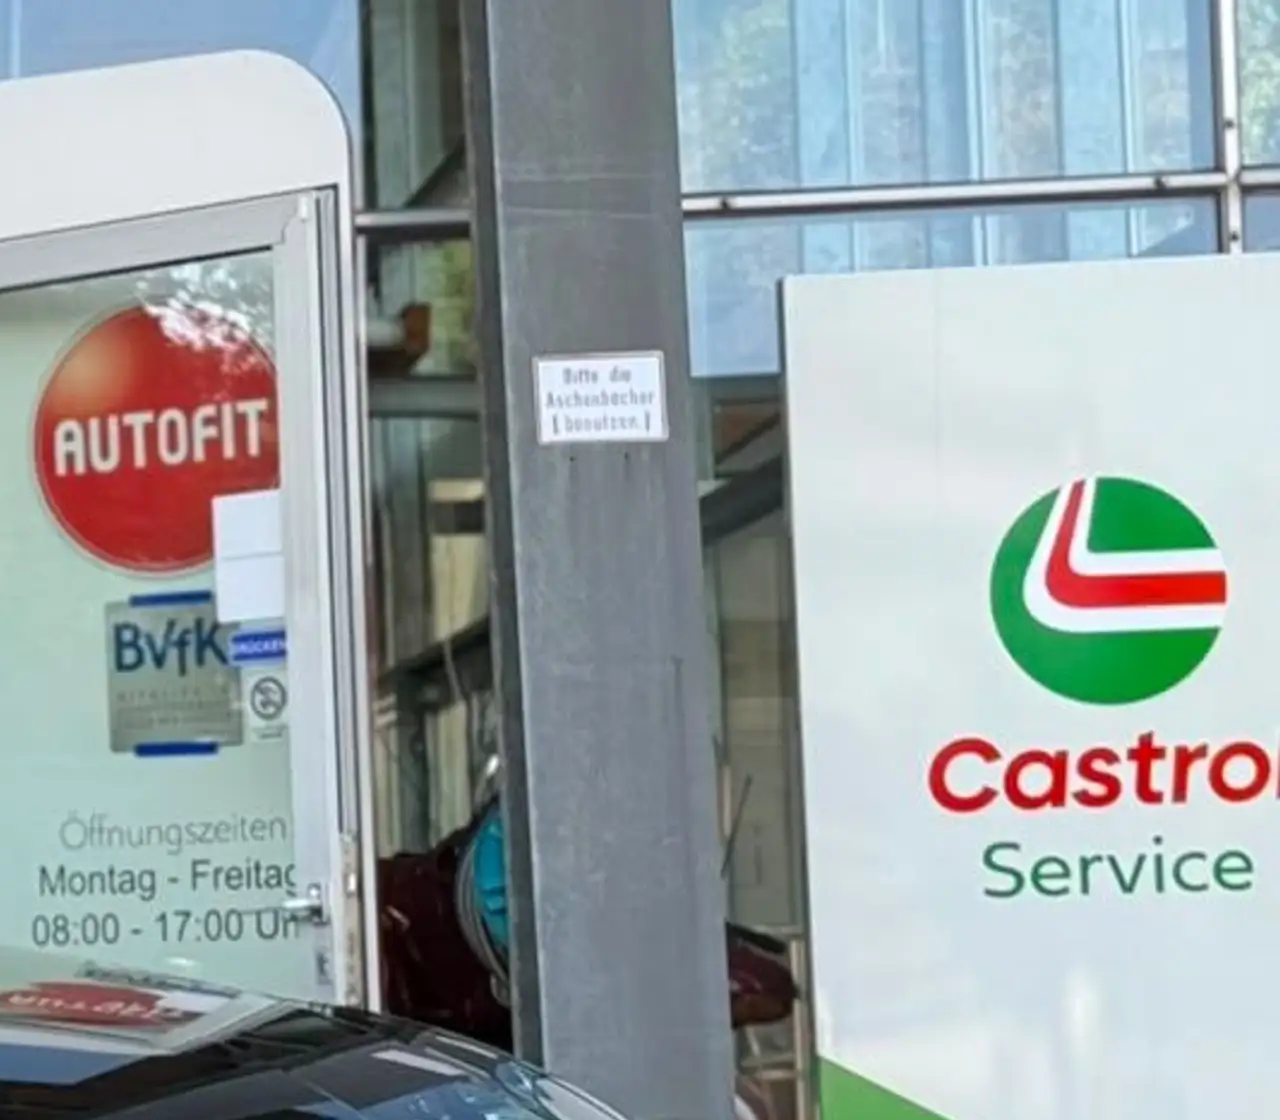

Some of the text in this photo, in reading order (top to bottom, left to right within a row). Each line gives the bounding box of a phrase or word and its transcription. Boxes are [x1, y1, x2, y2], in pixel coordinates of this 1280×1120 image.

[54, 399, 268, 477] AUTOFIT
[114, 617, 229, 677] BVfK
[39, 863, 157, 901] Montag
[982, 835, 1254, 898] Service
[32, 912, 120, 947] 08:00
[154, 909, 244, 943] 17:00
